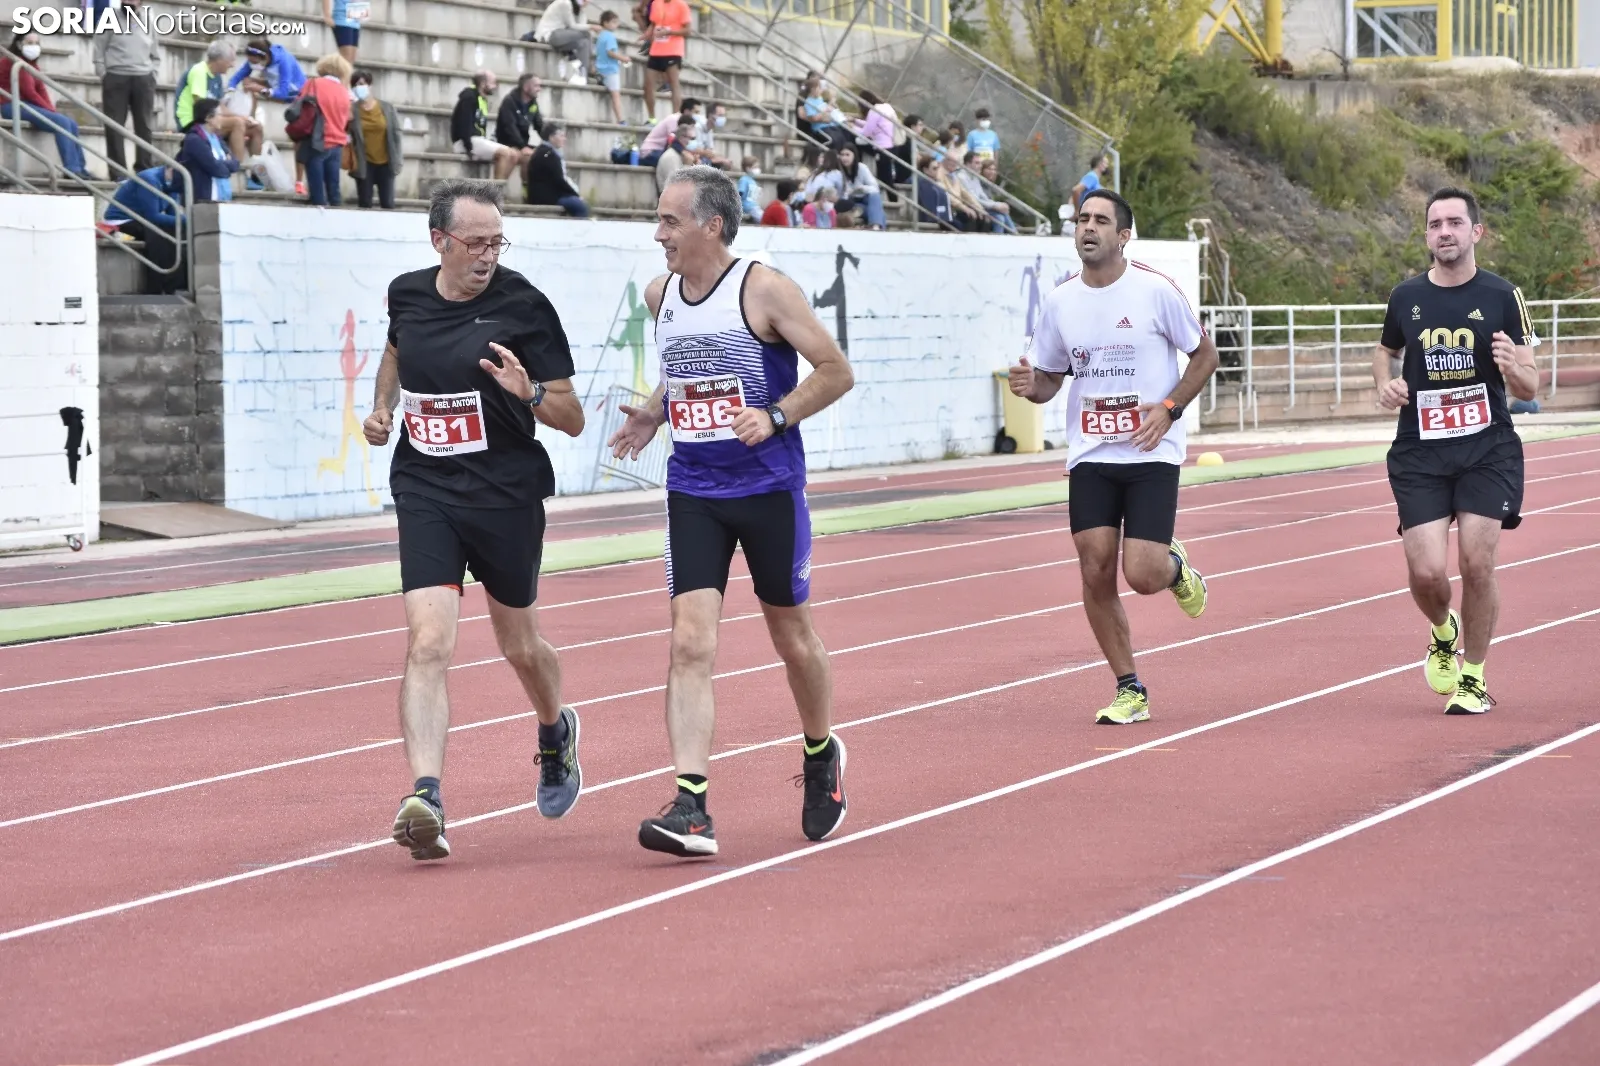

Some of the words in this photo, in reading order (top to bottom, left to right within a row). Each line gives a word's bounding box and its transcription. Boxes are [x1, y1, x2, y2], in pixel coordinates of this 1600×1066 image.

[1418, 327, 1475, 350] 100
[673, 361, 715, 373] SORIA
[1425, 354, 1474, 370] BEHOBIA
[1092, 366, 1136, 379] Martínez
[696, 383, 713, 393] ABEL
[1452, 392, 1465, 400] ABEL
[434, 401, 450, 409] ABEL
[675, 400, 735, 429] 386
[1428, 404, 1481, 429] 218
[410, 416, 469, 444] 381
[1086, 412, 1134, 434] 266
[694, 431, 716, 439] JESUS
